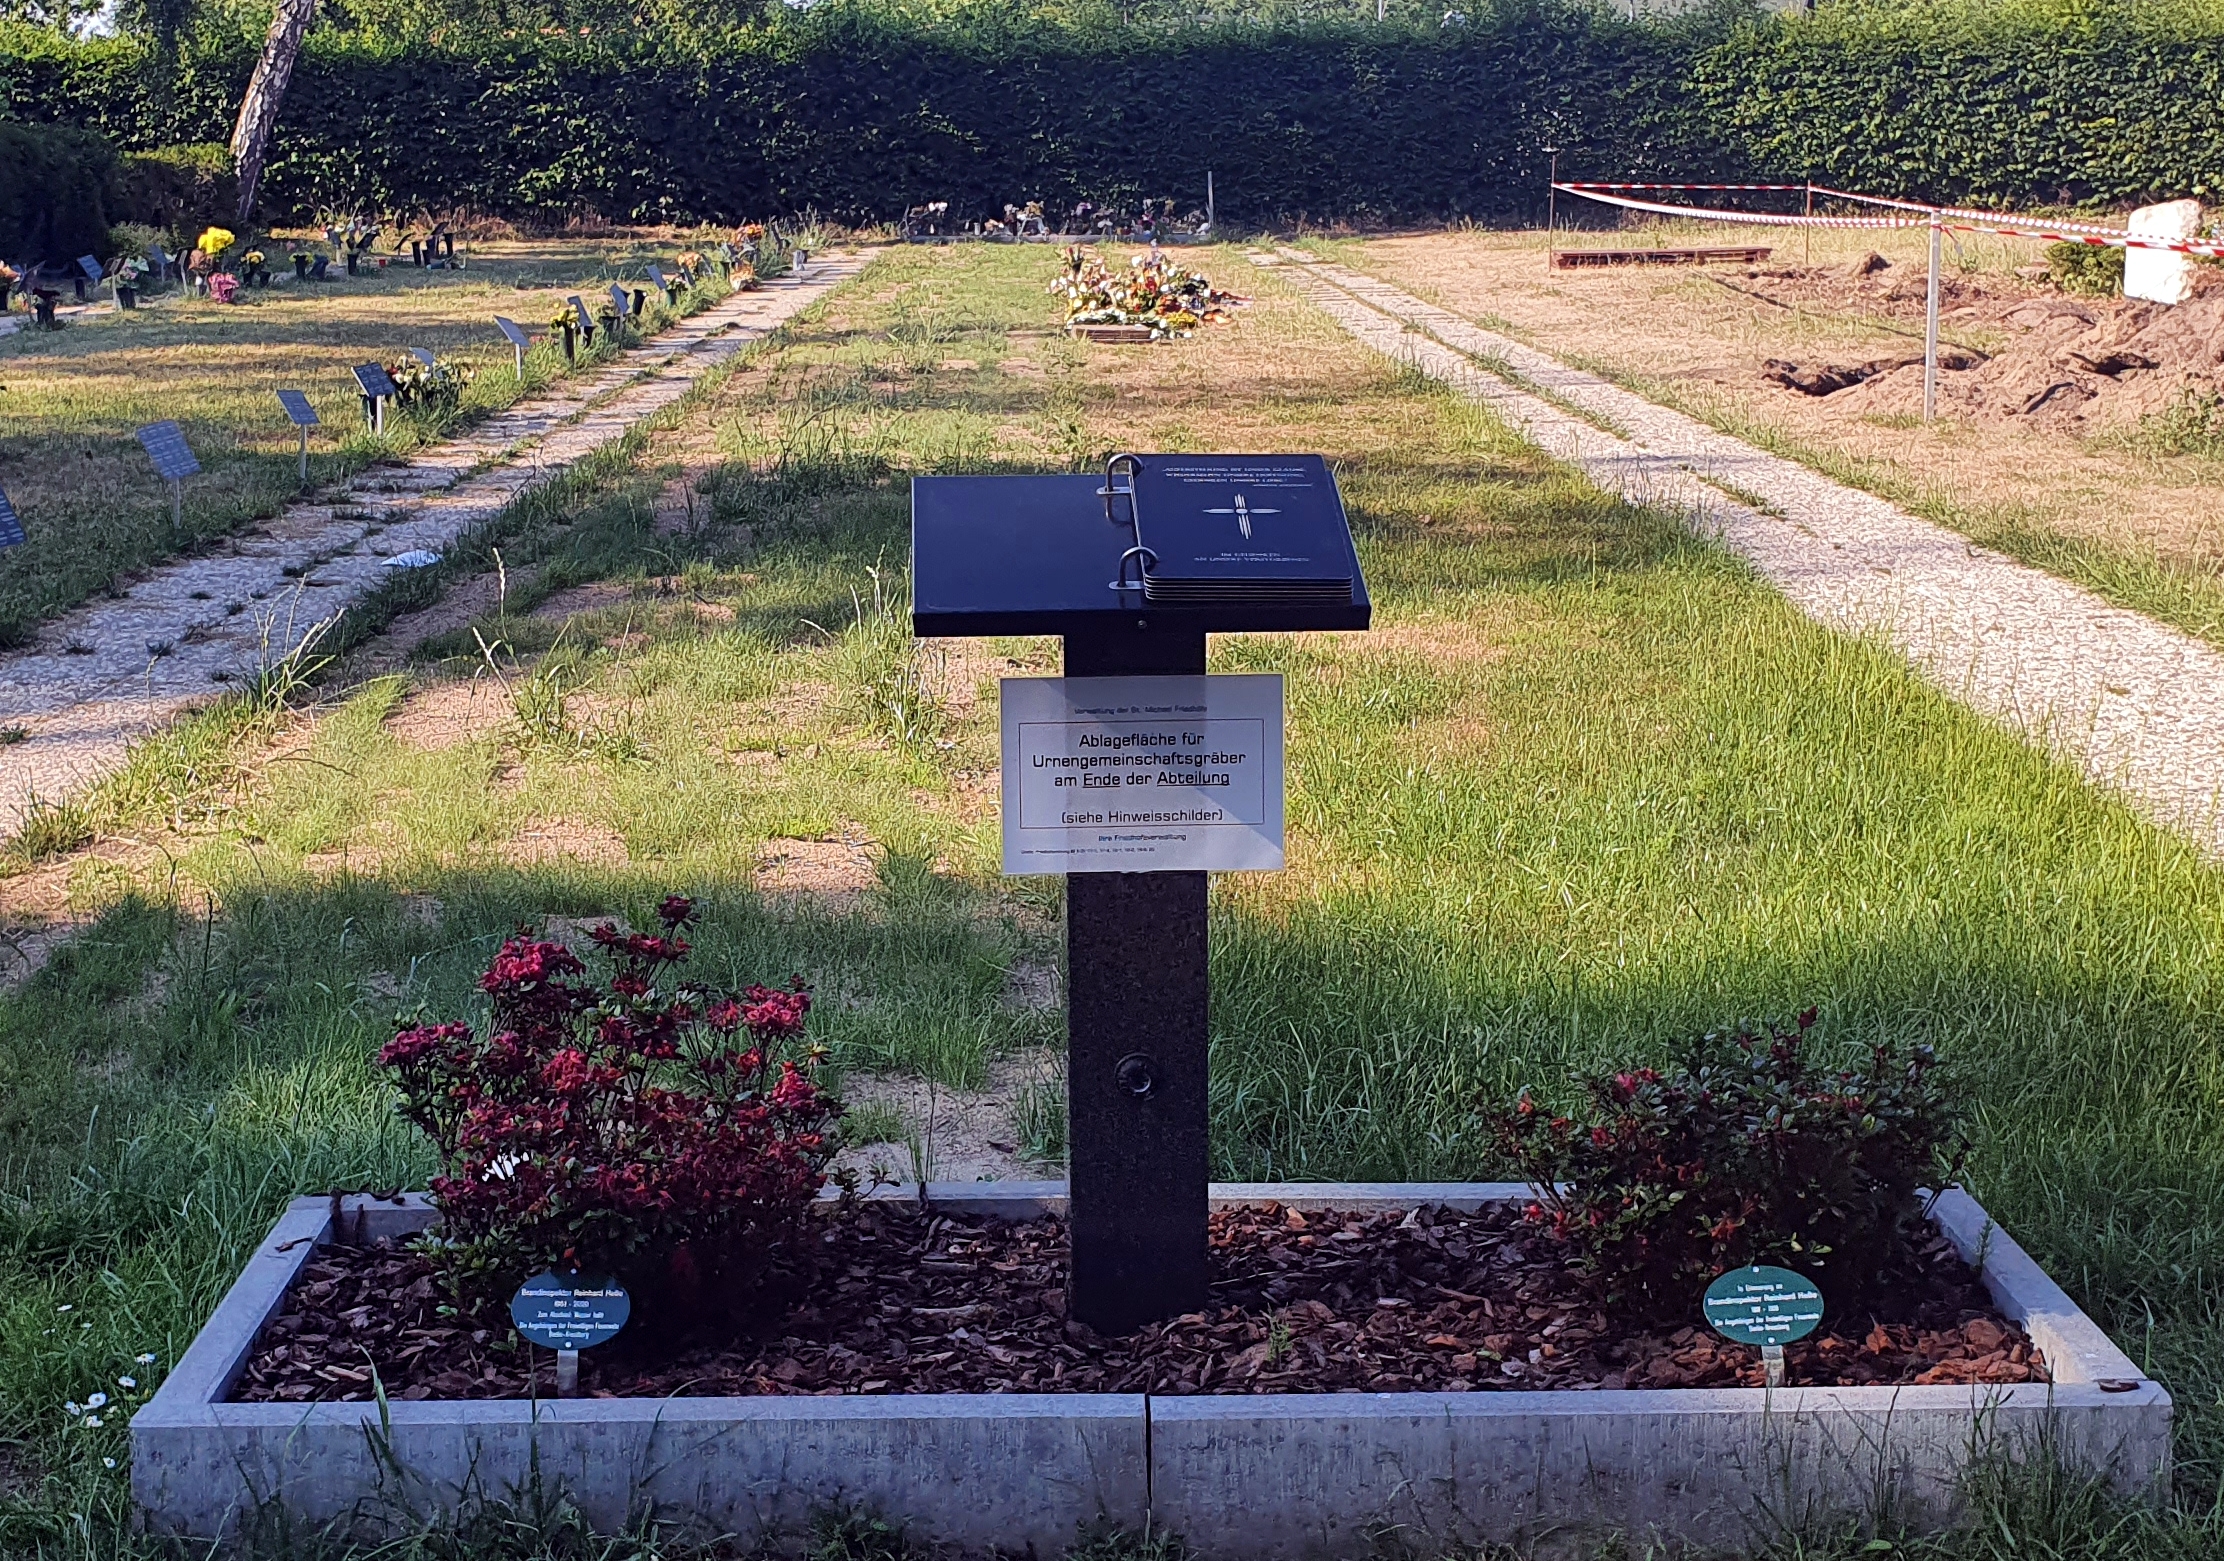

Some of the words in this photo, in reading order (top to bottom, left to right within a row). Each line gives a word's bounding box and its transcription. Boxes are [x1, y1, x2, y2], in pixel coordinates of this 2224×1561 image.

[1078, 733, 1177, 750] Ablagefläche
[1182, 732, 1205, 745] für
[1032, 753, 1246, 769] Urnengemeinschaftsgräber
[1054, 775, 1077, 787] am
[1083, 773, 1121, 787] Ende
[1126, 772, 1152, 786] der
[1157, 771, 1230, 786] Abteilung
[1061, 811, 1103, 825] (siehe
[1108, 808, 1224, 823] Hinweisschilder)
